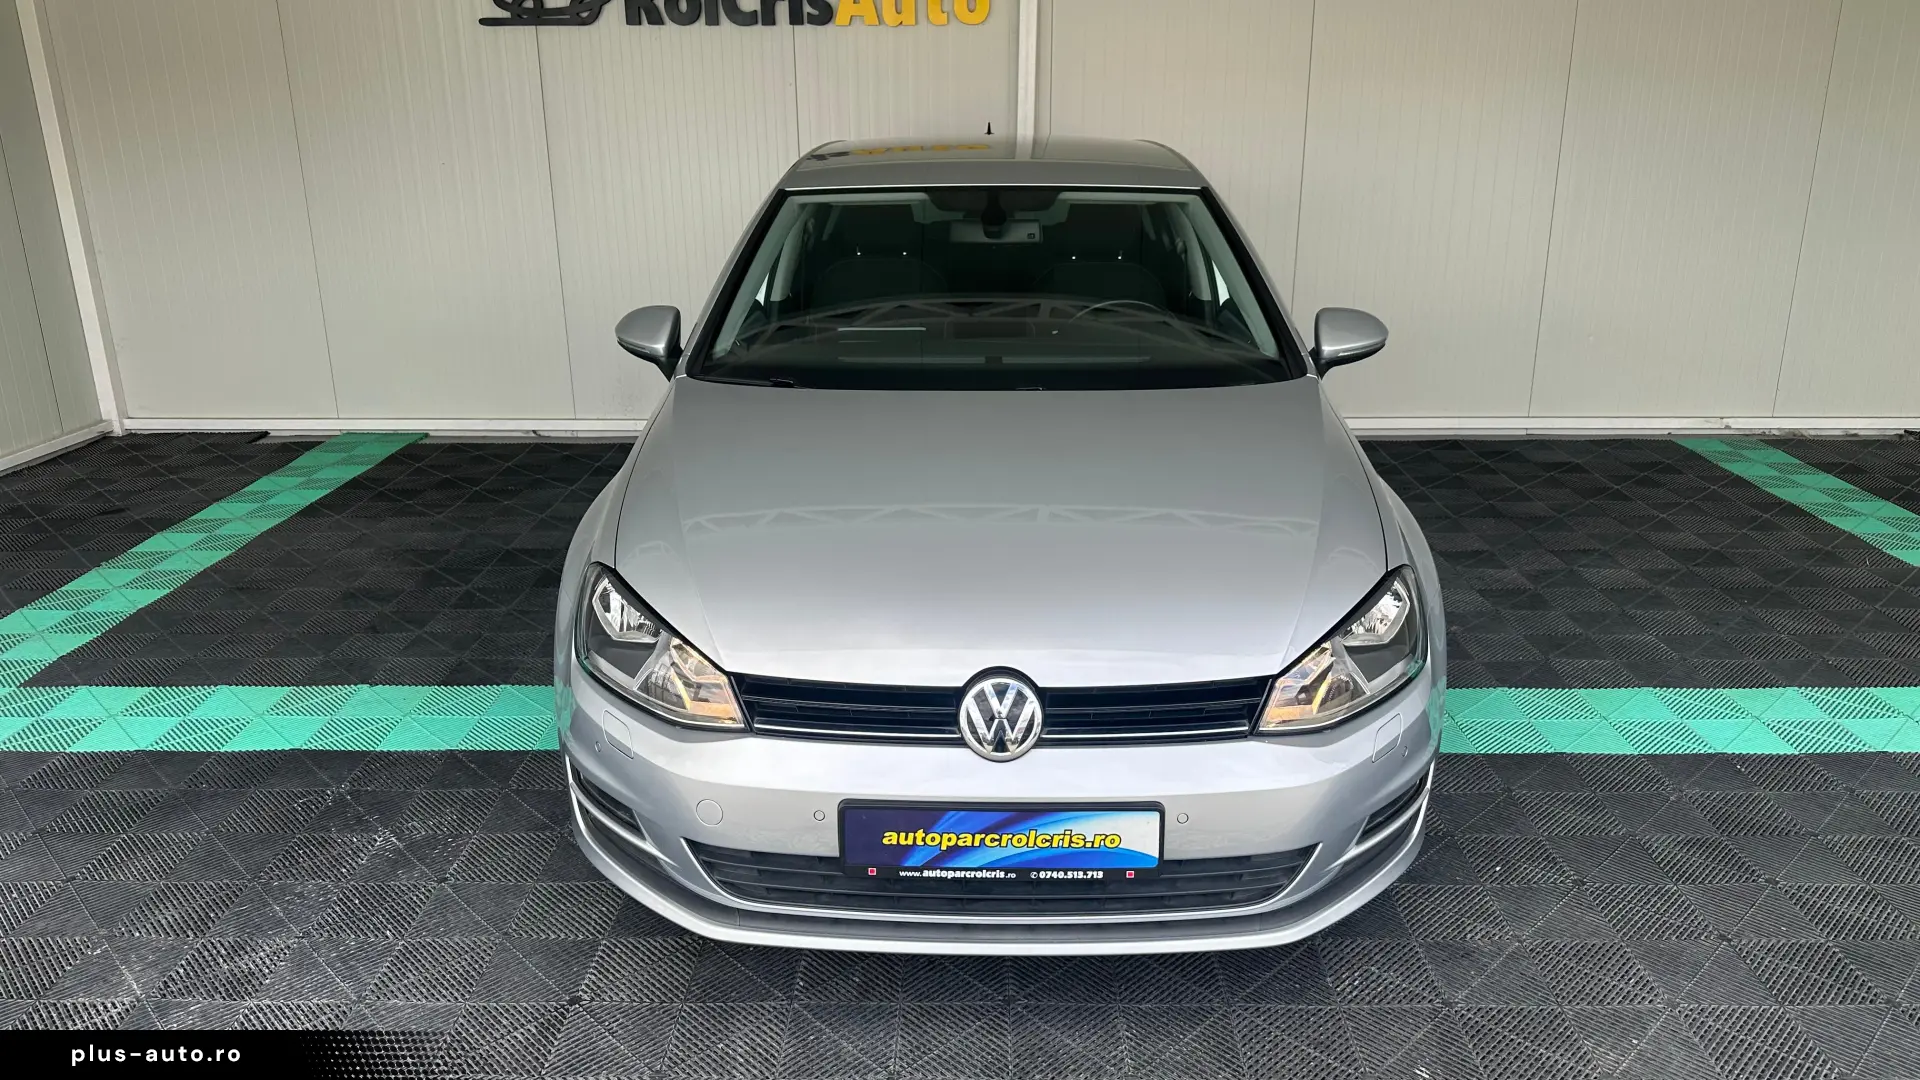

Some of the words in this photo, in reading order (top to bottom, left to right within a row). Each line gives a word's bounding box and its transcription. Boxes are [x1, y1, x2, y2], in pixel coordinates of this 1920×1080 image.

[961, 679, 1041, 759] VW
[882, 829, 1121, 850] autoparcrolcris.ro
[899, 869, 1016, 879] www.autoparcrolcris.ro
